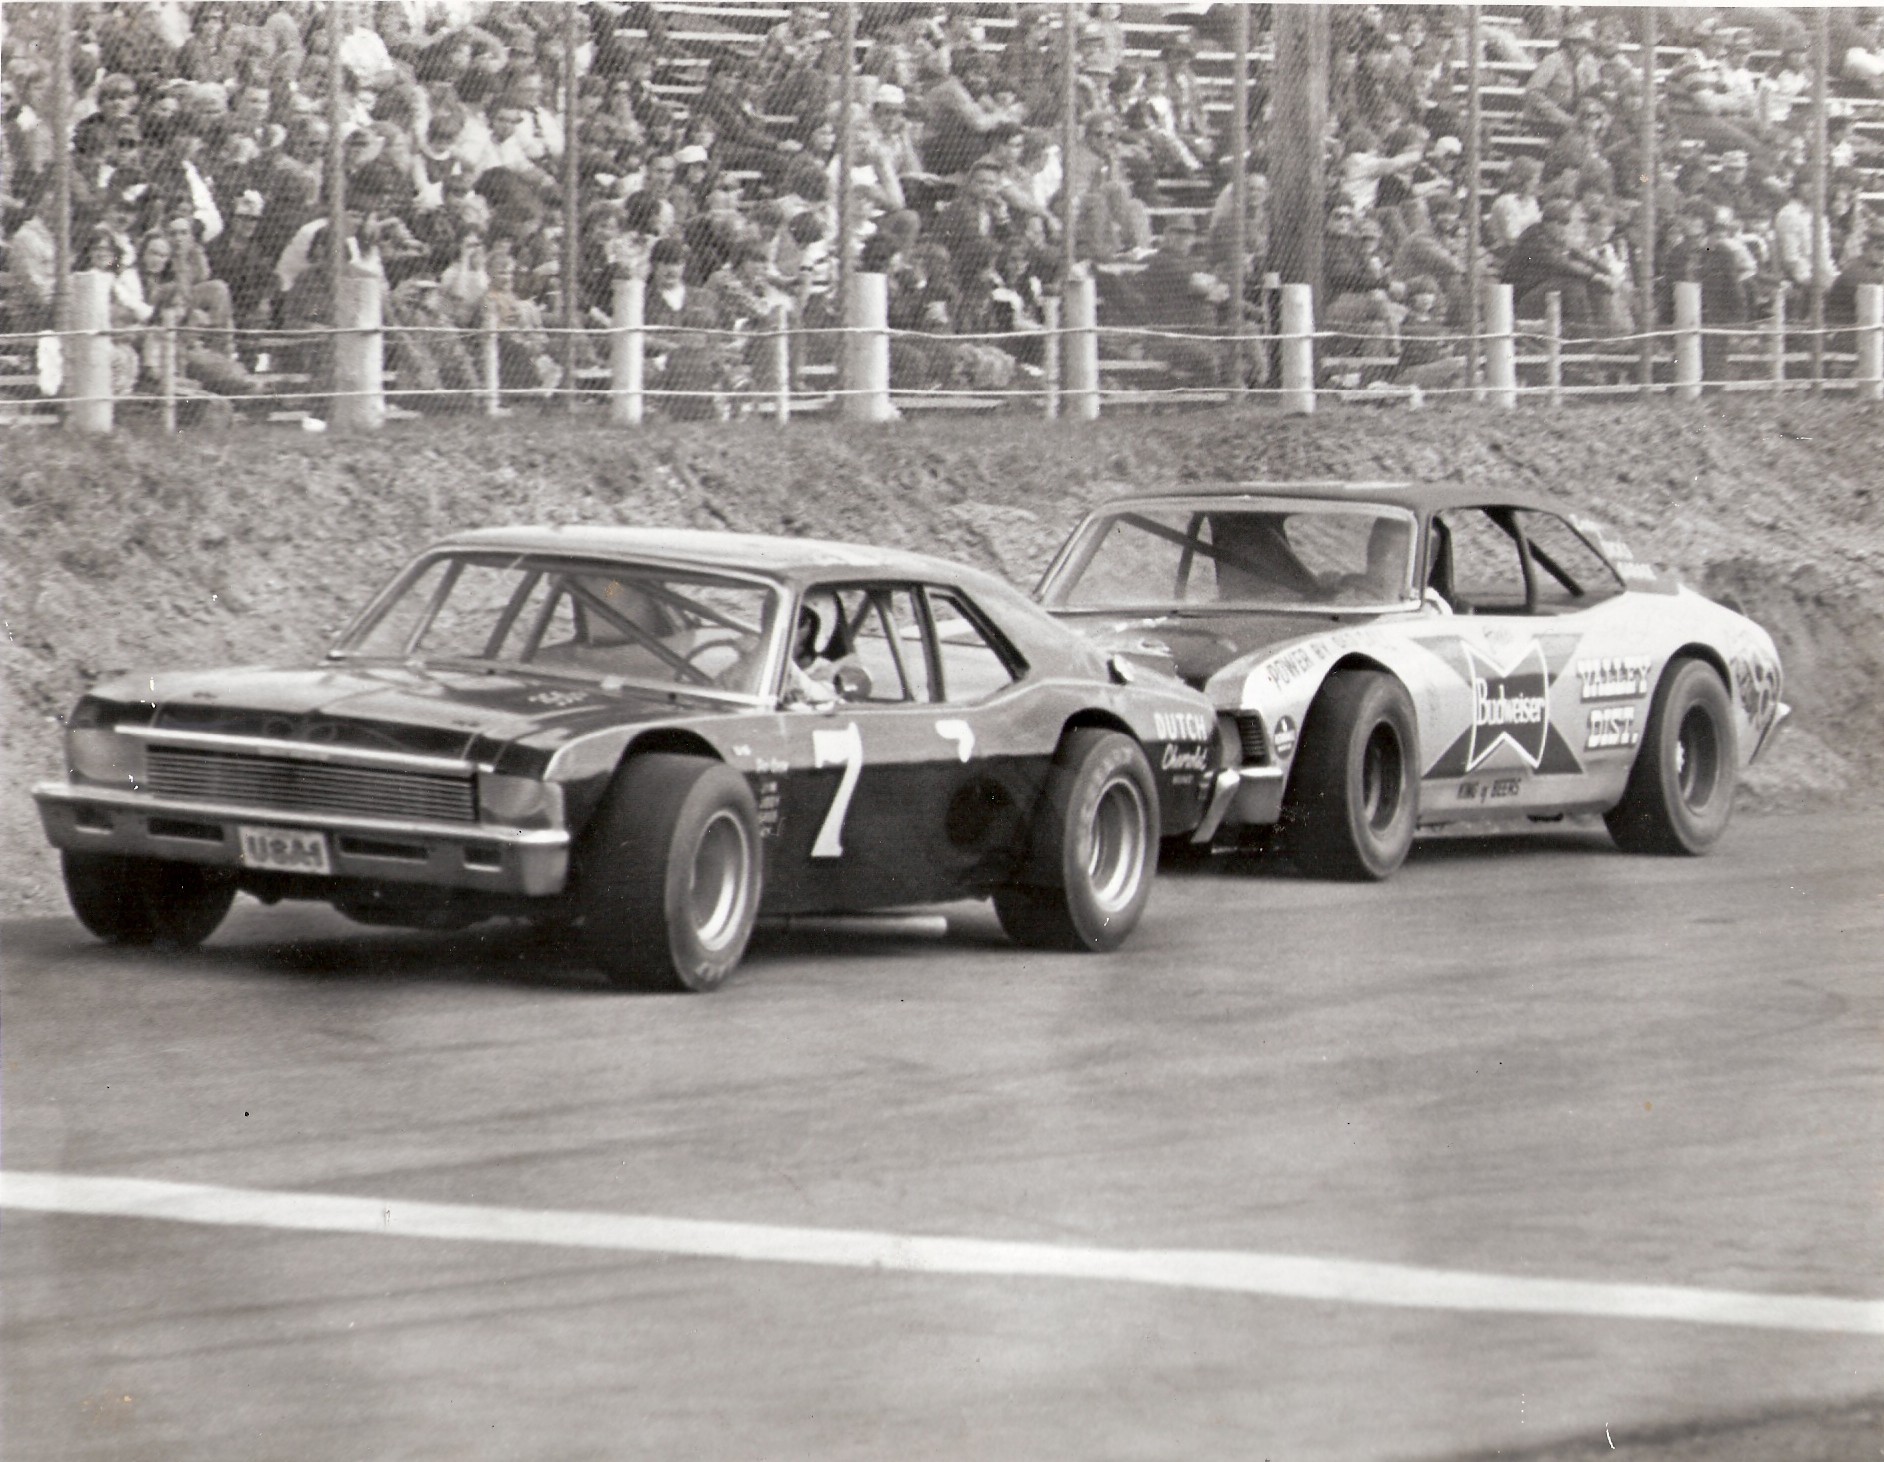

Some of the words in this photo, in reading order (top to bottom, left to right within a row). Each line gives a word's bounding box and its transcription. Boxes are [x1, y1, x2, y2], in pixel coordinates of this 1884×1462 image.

[1577, 656, 1651, 698] VALLEY
[1475, 677, 1545, 726] Budweiser
[1154, 712, 1208, 740] DUTCH
[1587, 706, 1638, 748] DIST.
[811, 721, 863, 857] 7
[1457, 781, 1480, 799] KING
[1490, 777, 1522, 798] BEERS
